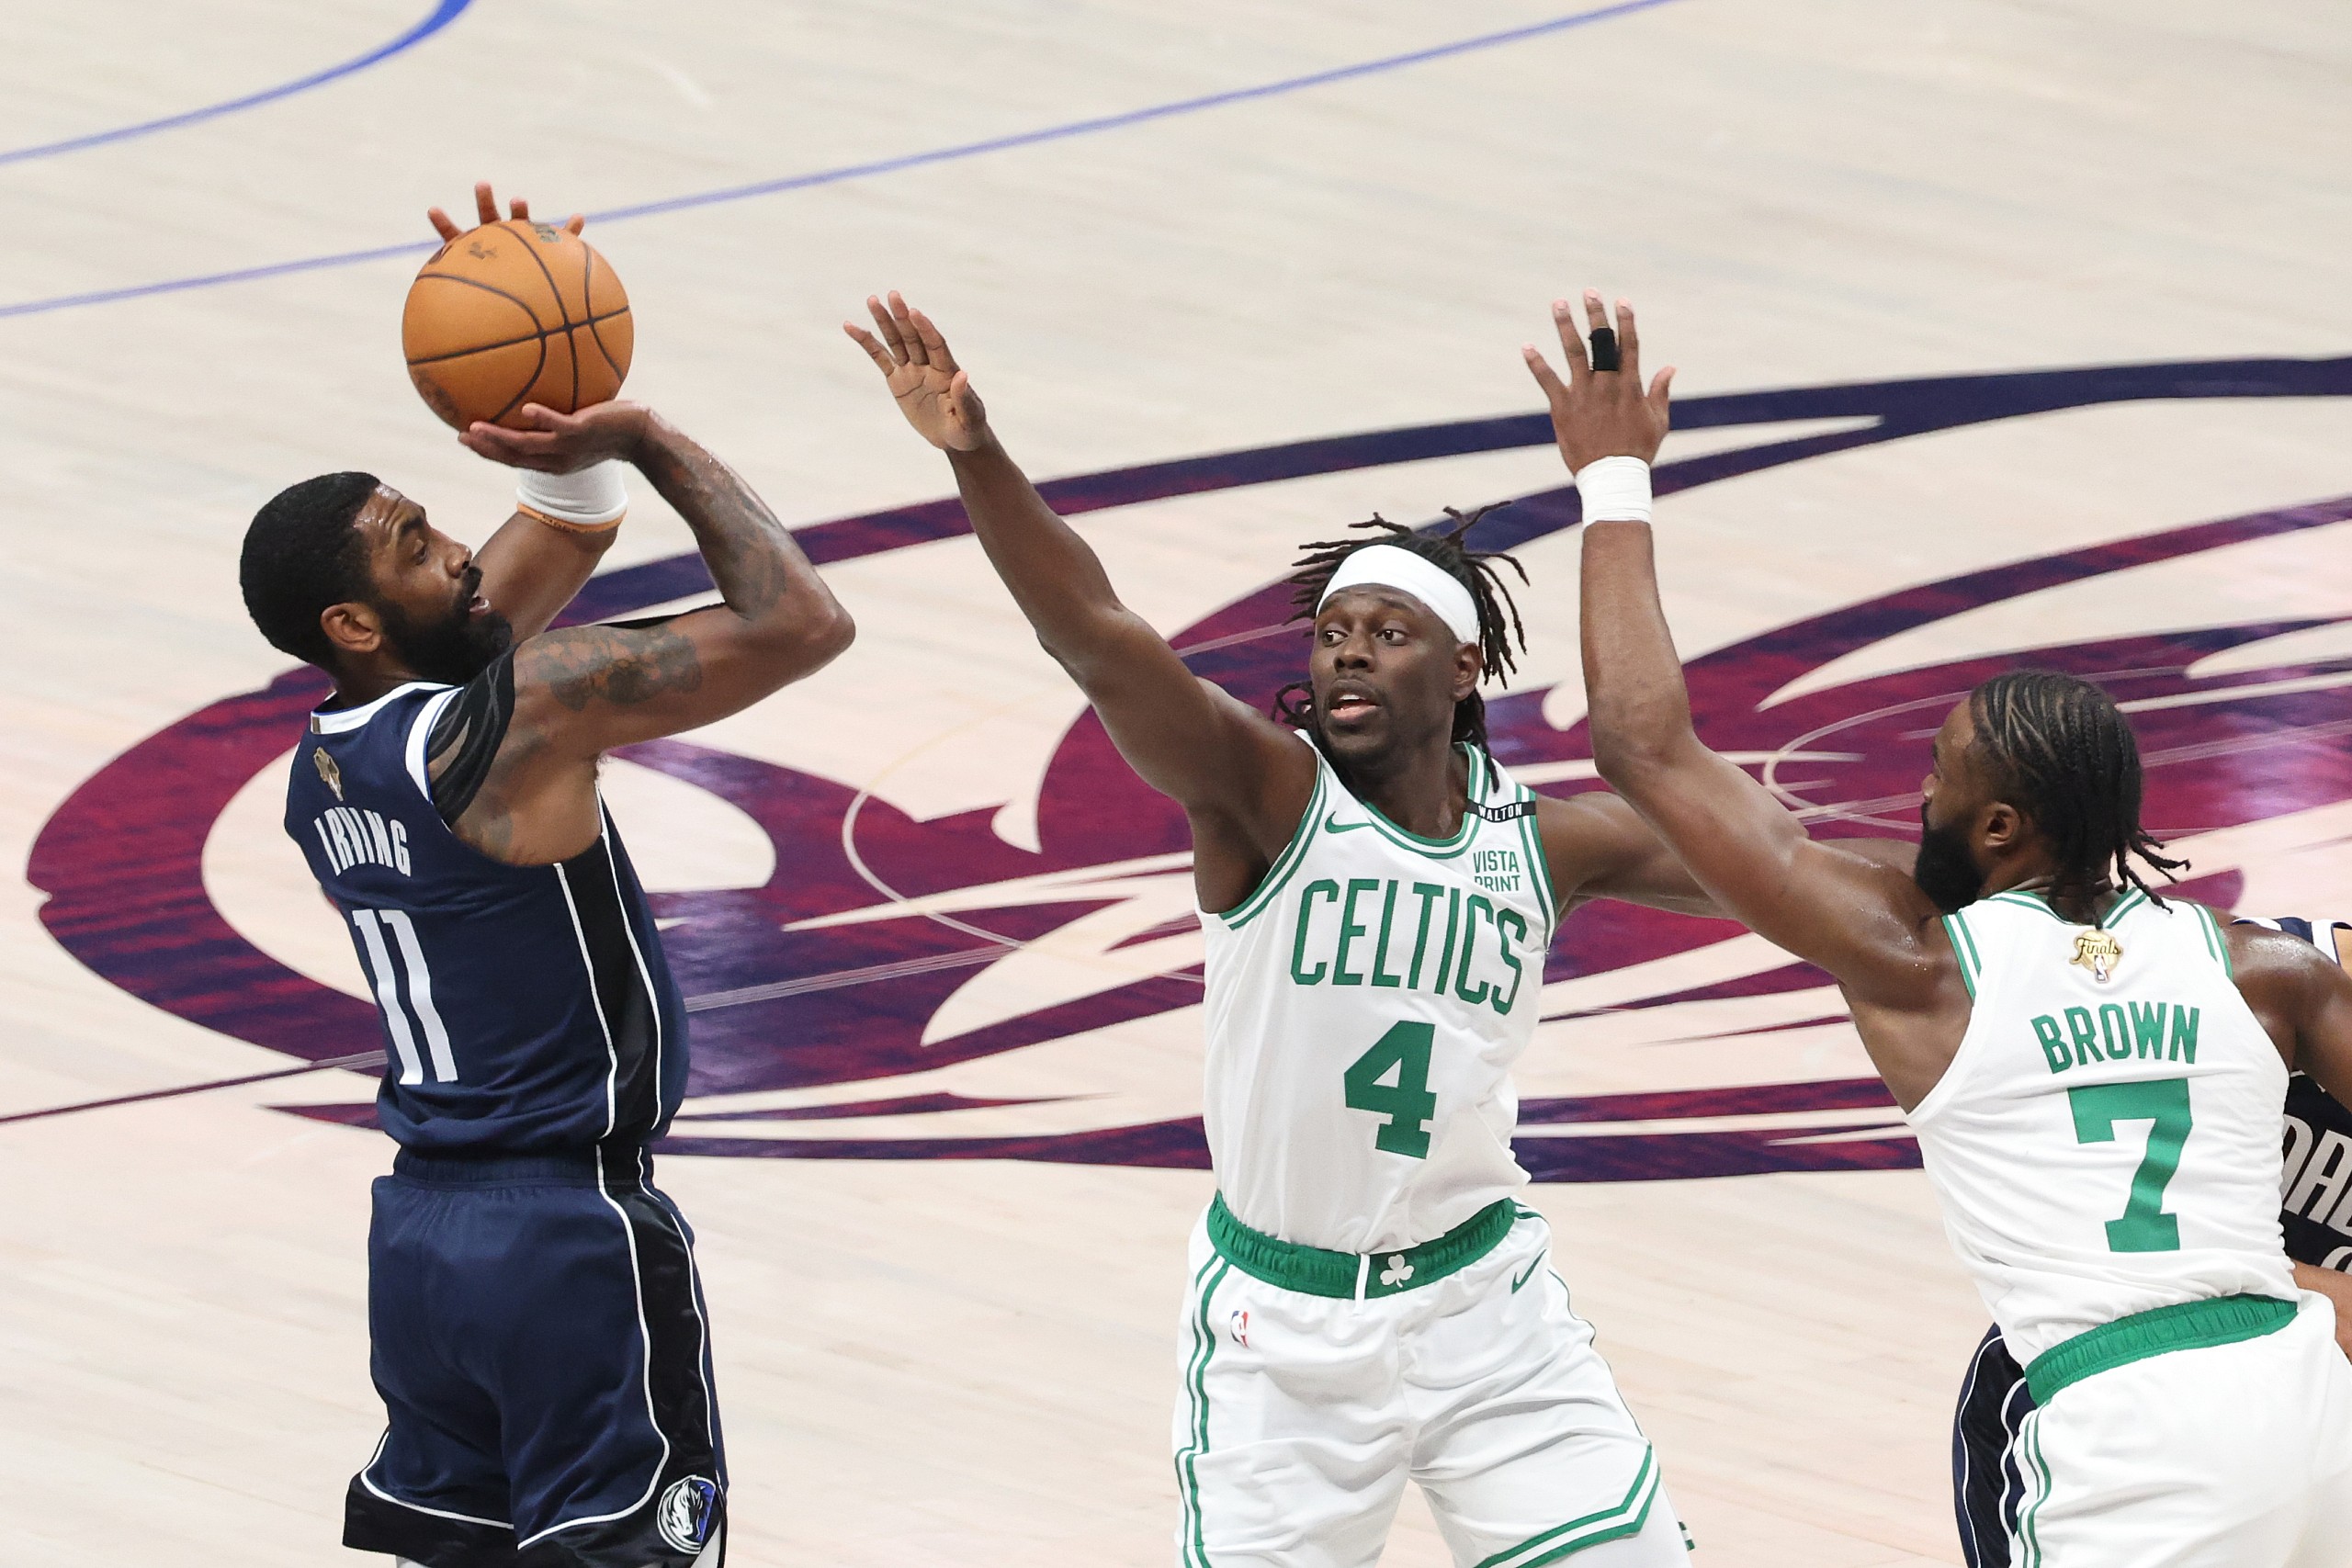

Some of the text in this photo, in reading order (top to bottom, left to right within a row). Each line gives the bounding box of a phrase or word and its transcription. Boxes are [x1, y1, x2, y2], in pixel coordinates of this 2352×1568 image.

[313, 807, 412, 877] IRVING
[1478, 802, 1522, 822] WALTON
[1473, 850, 1520, 874] VISTA
[1290, 878, 1527, 1016] CELTICS
[2074, 937, 2121, 962] Finals
[352, 908, 458, 1085] 11
[2030, 1001, 2200, 1075] BROWN
[1343, 1020, 1437, 1159] 4
[2067, 1077, 2194, 1252] 7
